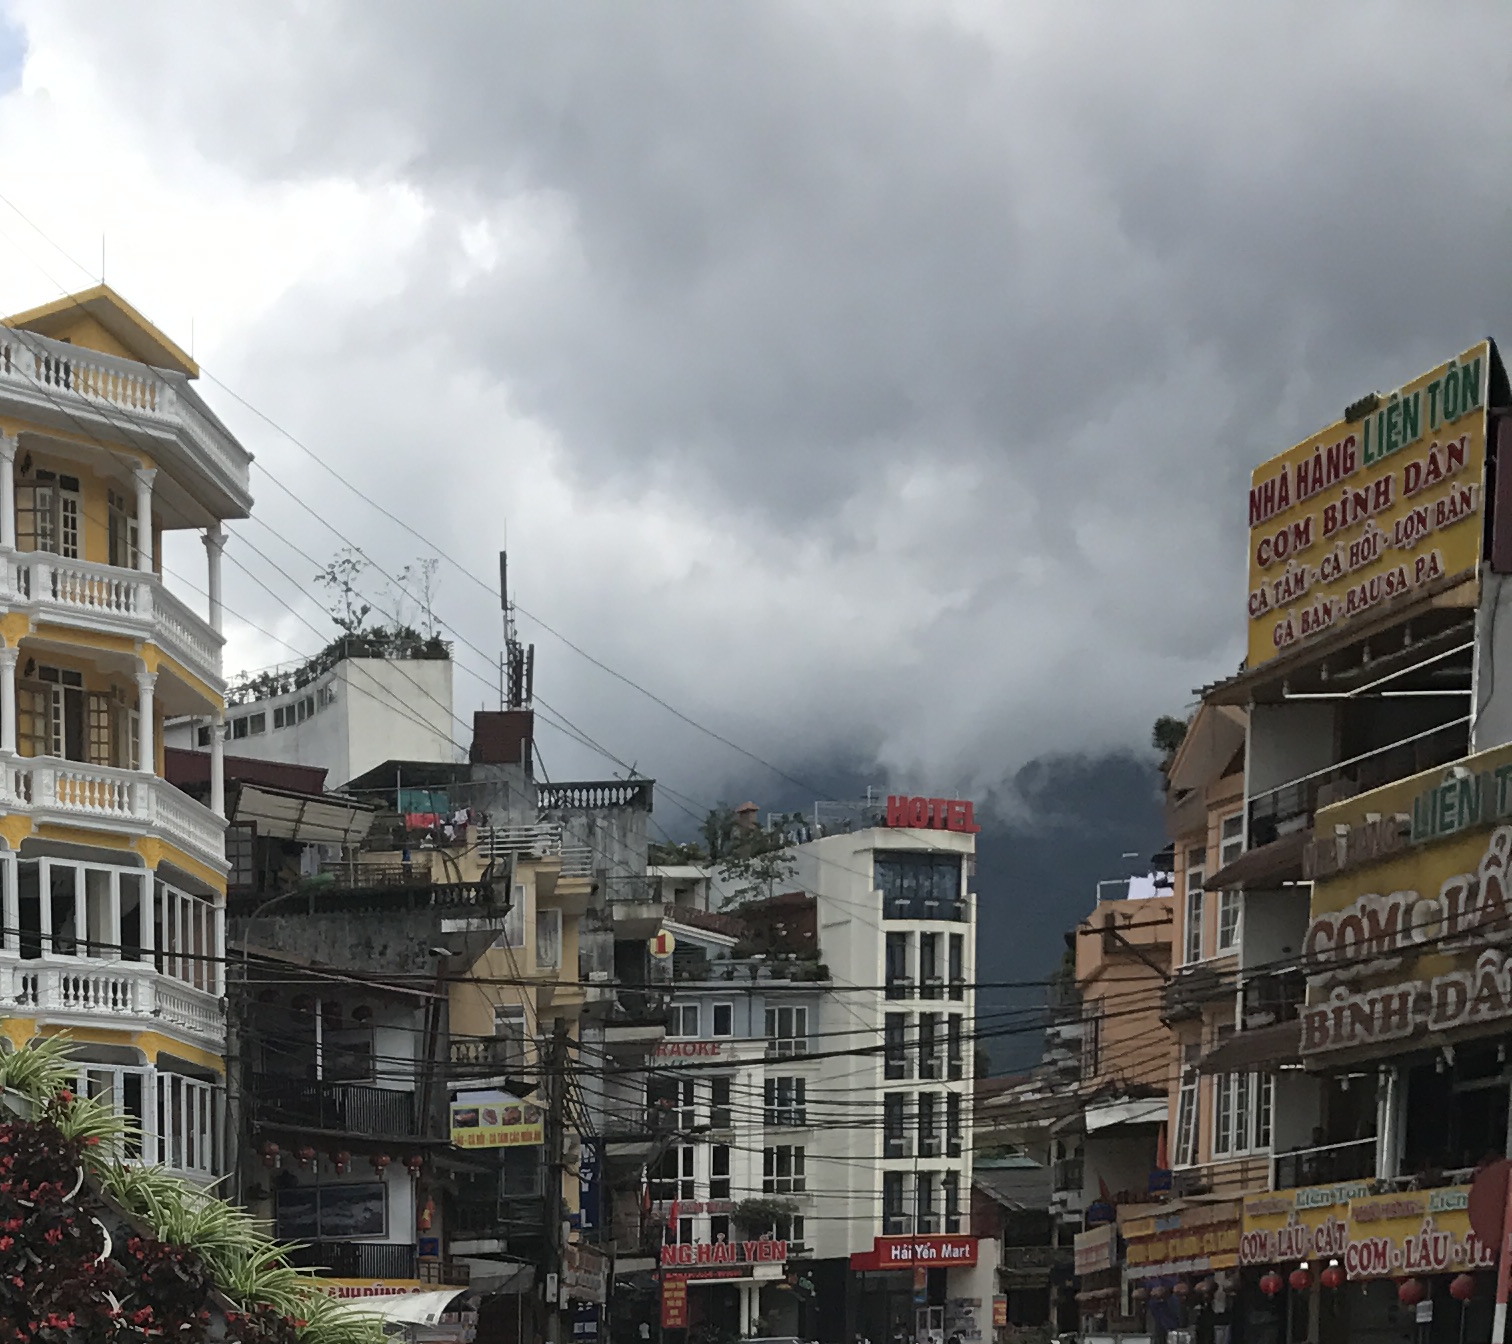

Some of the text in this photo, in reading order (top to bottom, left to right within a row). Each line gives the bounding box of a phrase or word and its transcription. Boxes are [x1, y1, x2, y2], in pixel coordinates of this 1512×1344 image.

[1297, 435, 1356, 500] HÀNG
[1363, 392, 1420, 465] LIÊN
[1428, 358, 1481, 430] TÔN
[1257, 436, 1468, 567] CƠM BÌNH DÂN
[1346, 576, 1381, 615] RAU
[887, 795, 981, 833] HOTEL
[1305, 957, 1512, 1050] BÌNH DÂ
[655, 1042, 722, 1057] RAOKE
[941, 1243, 970, 1258] Mart
[1346, 1238, 1388, 1273] CƠM
[1405, 1219, 1449, 1269] LẨU
